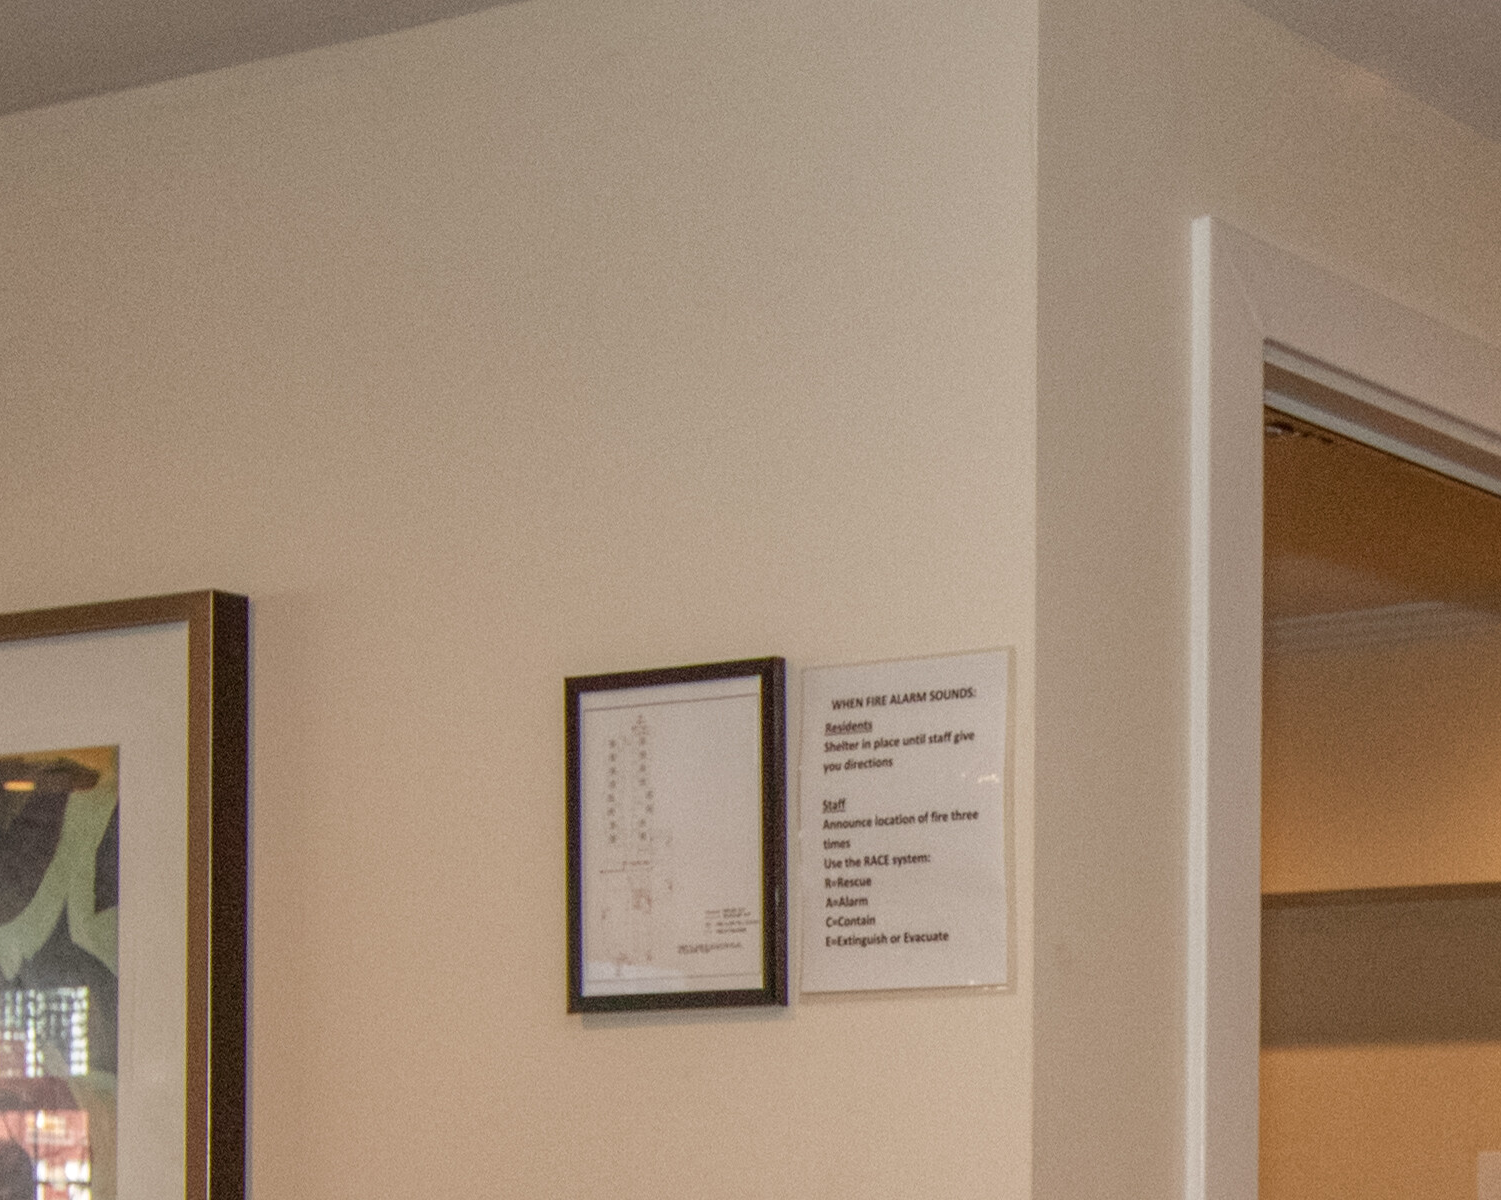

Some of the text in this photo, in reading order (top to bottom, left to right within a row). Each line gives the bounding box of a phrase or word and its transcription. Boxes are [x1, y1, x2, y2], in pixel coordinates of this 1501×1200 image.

[831, 687, 977, 710] WHEN FIRE ALARM SOUNDS:
[825, 721, 873, 735] Residents
[824, 730, 975, 752] Shelter in place until staff give
[823, 757, 893, 774] you directions
[822, 798, 846, 812] Staff
[822, 809, 979, 830] Announce location of fire three
[823, 838, 851, 849] times
[824, 854, 931, 869] Use the RACE system:
[824, 877, 872, 888] R=Rescue
[825, 896, 868, 907] A=Alarm
[825, 915, 876, 928] C=Contain
[825, 931, 949, 947] E=Extinguish or Evacuate
